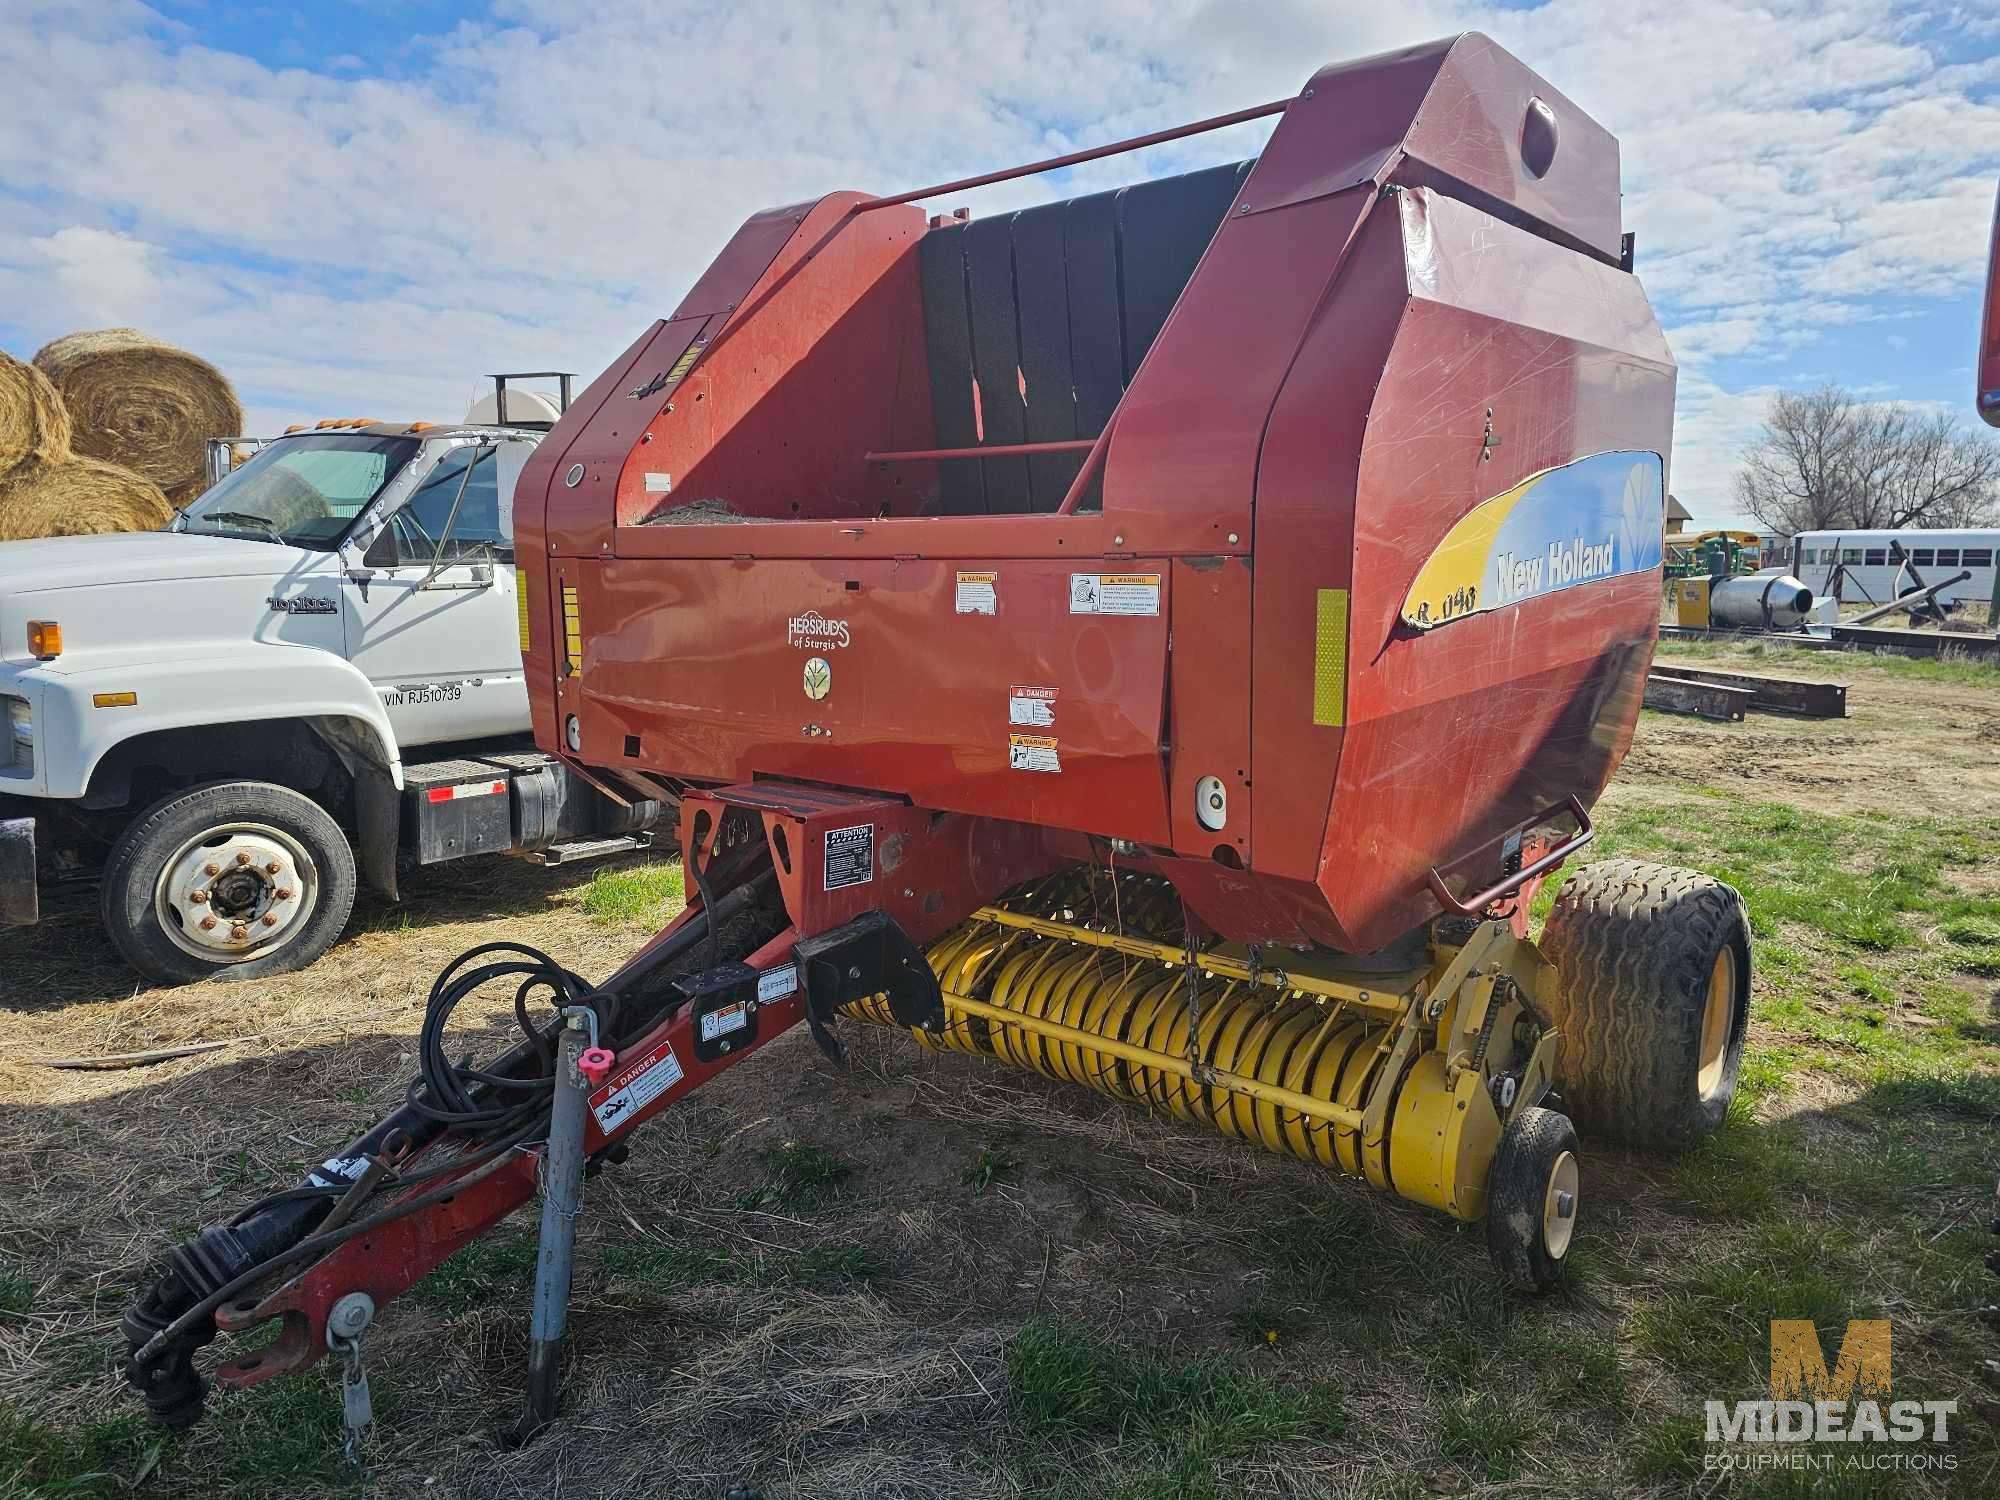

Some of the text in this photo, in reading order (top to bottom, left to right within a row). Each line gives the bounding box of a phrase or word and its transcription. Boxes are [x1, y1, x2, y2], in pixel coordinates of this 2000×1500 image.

[1497, 534, 1614, 601] New Holland
[788, 617, 850, 647] HERSRUDS
[794, 637, 836, 651] of Sturgis
[384, 687, 462, 706] VIN RJ510739
[1026, 689, 1053, 698] DANGER
[1024, 738, 1052, 747] WARNING
[831, 827, 869, 839] ATTENTION
[620, 1055, 657, 1086] DANGER
